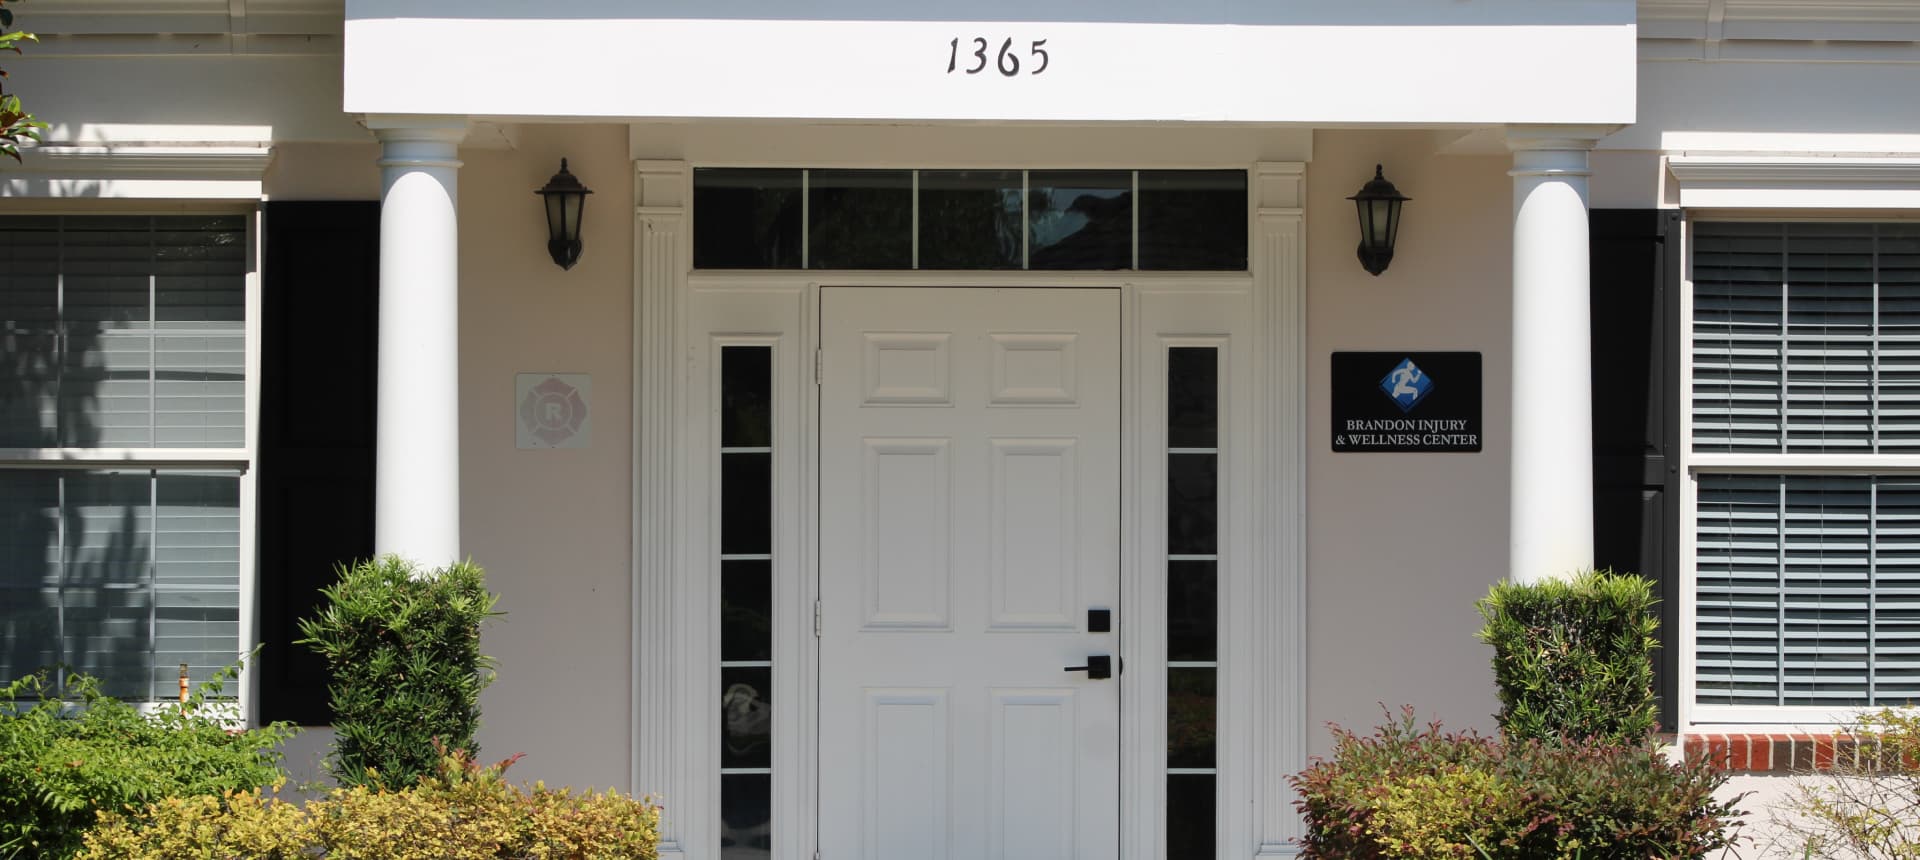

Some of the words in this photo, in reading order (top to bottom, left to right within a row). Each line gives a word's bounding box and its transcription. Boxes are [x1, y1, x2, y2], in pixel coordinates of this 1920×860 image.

[947, 36, 1049, 77] 1365
[544, 402, 563, 421] R
[1346, 419, 1415, 431] BRANDON
[1418, 419, 1467, 433] INJURY
[1335, 435, 1345, 445] &
[1348, 434, 1420, 446] WELLNESS
[1422, 434, 1478, 446] CENTER
